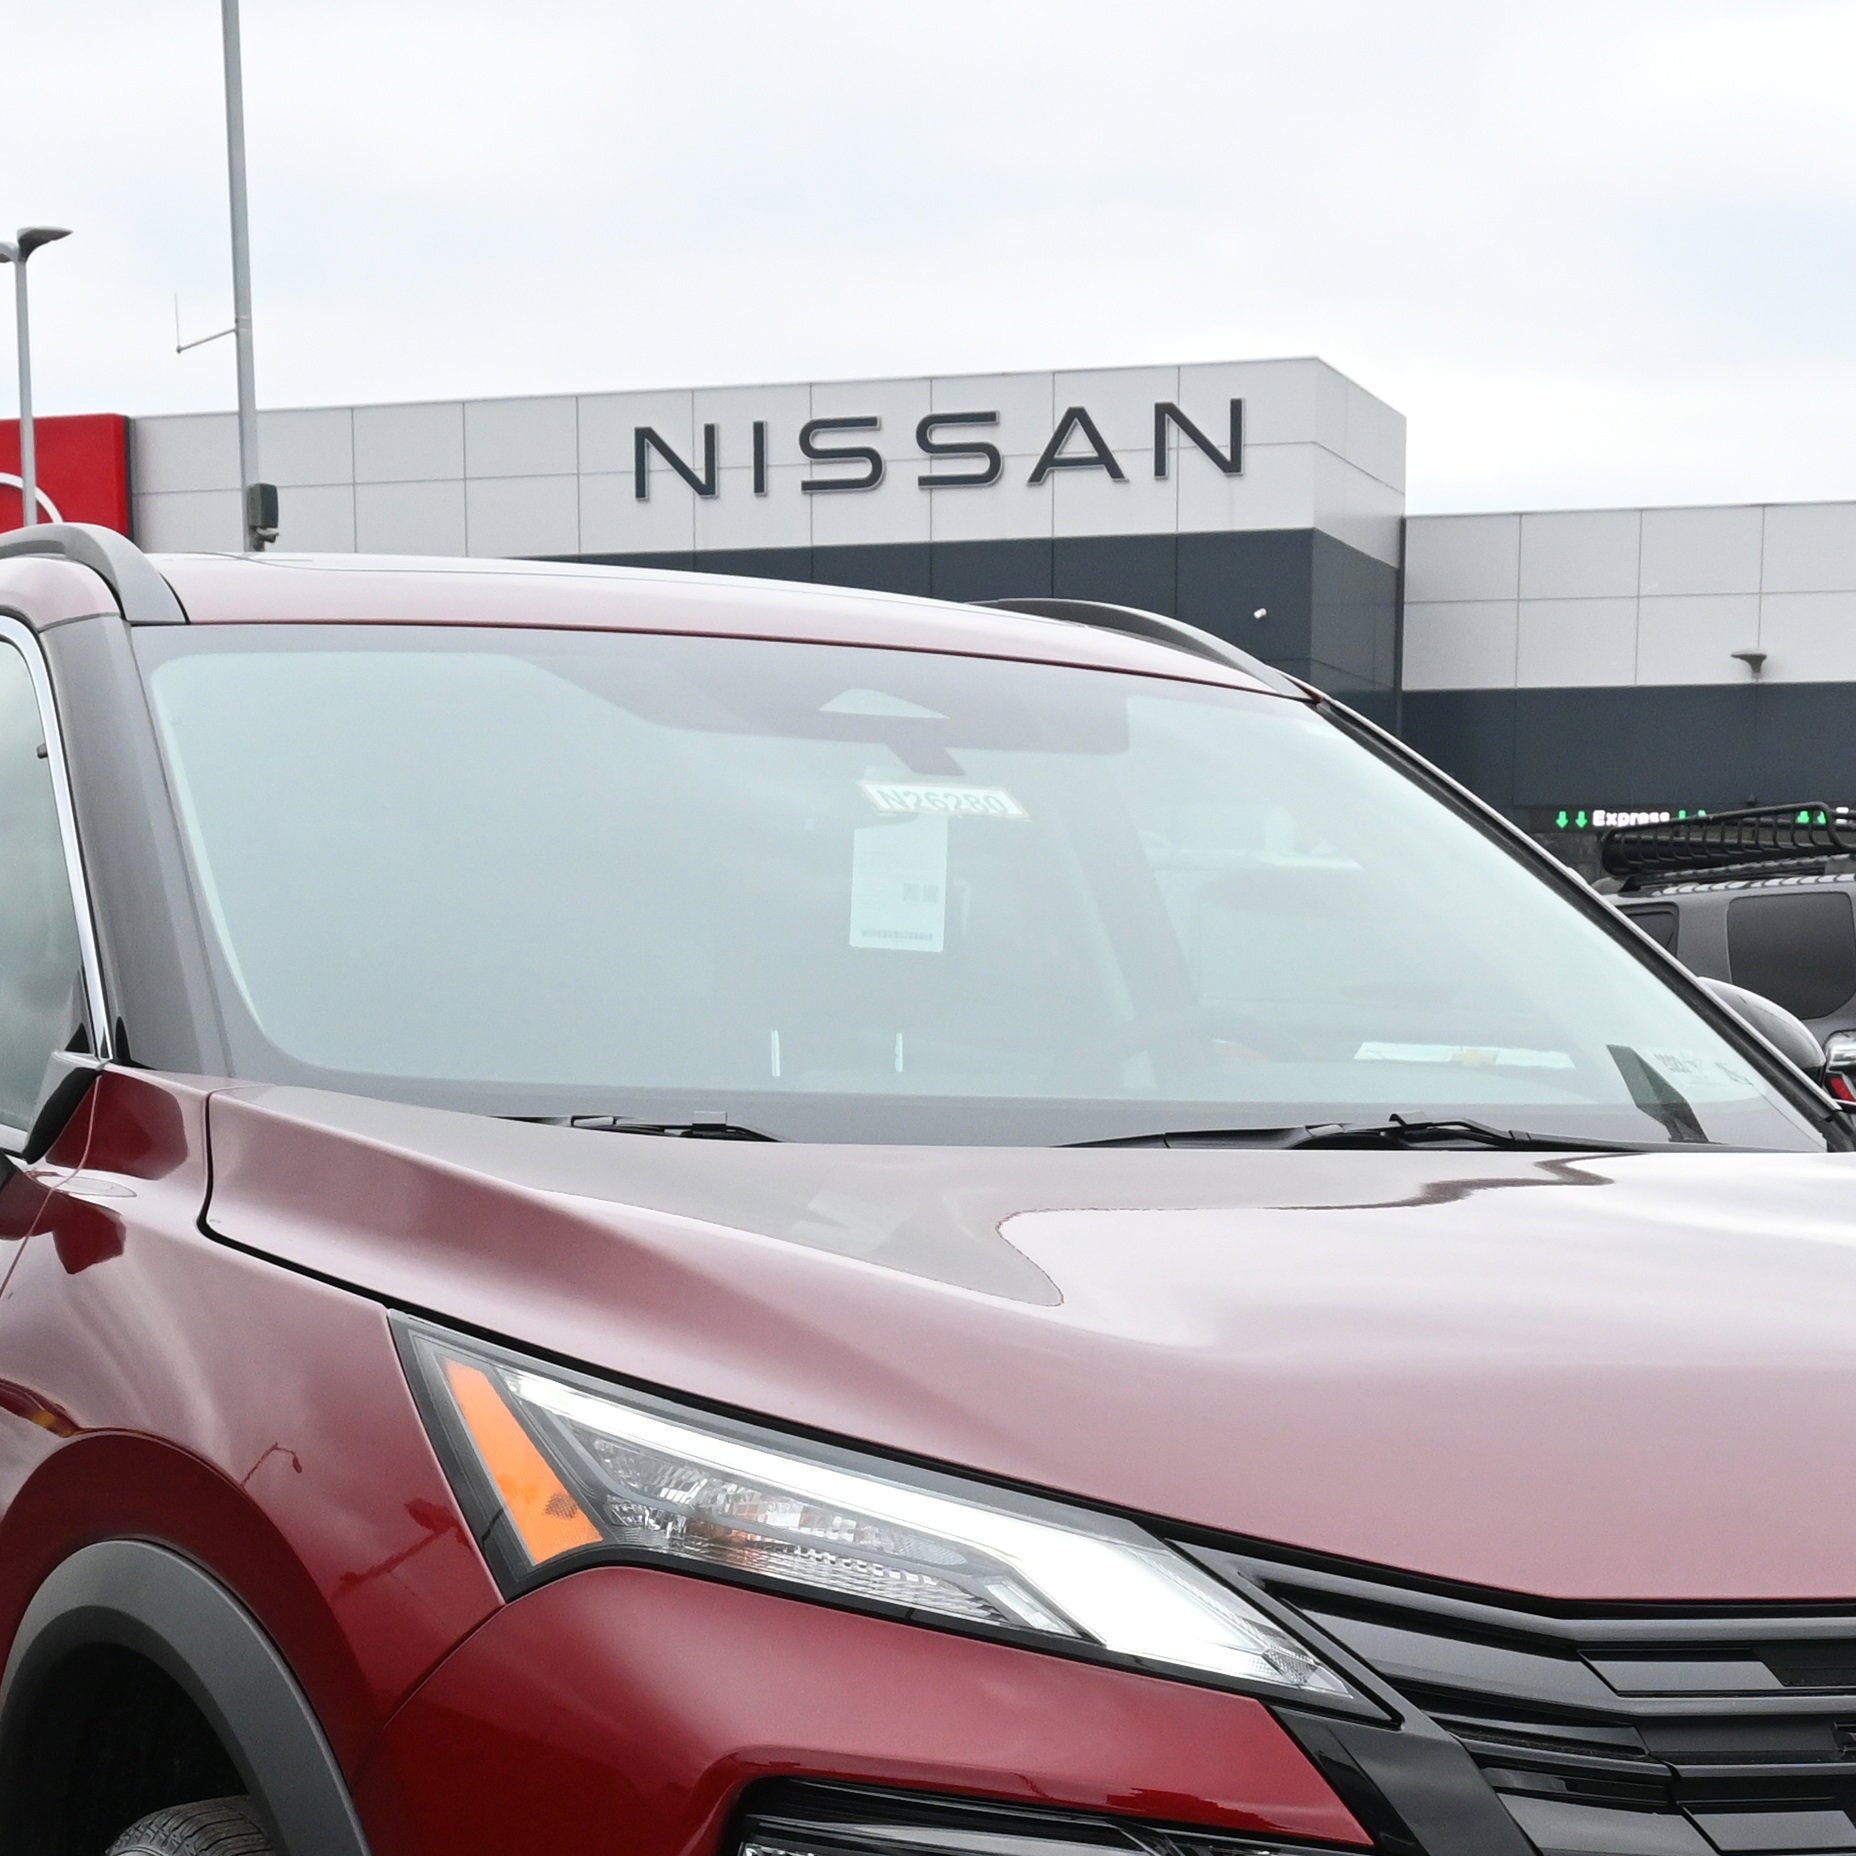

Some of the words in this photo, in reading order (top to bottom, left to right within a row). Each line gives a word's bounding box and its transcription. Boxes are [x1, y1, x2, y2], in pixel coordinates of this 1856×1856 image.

[634, 398, 1245, 501] NISSAN
[876, 789, 1011, 817] N26280
[1592, 809, 1671, 828] Express
